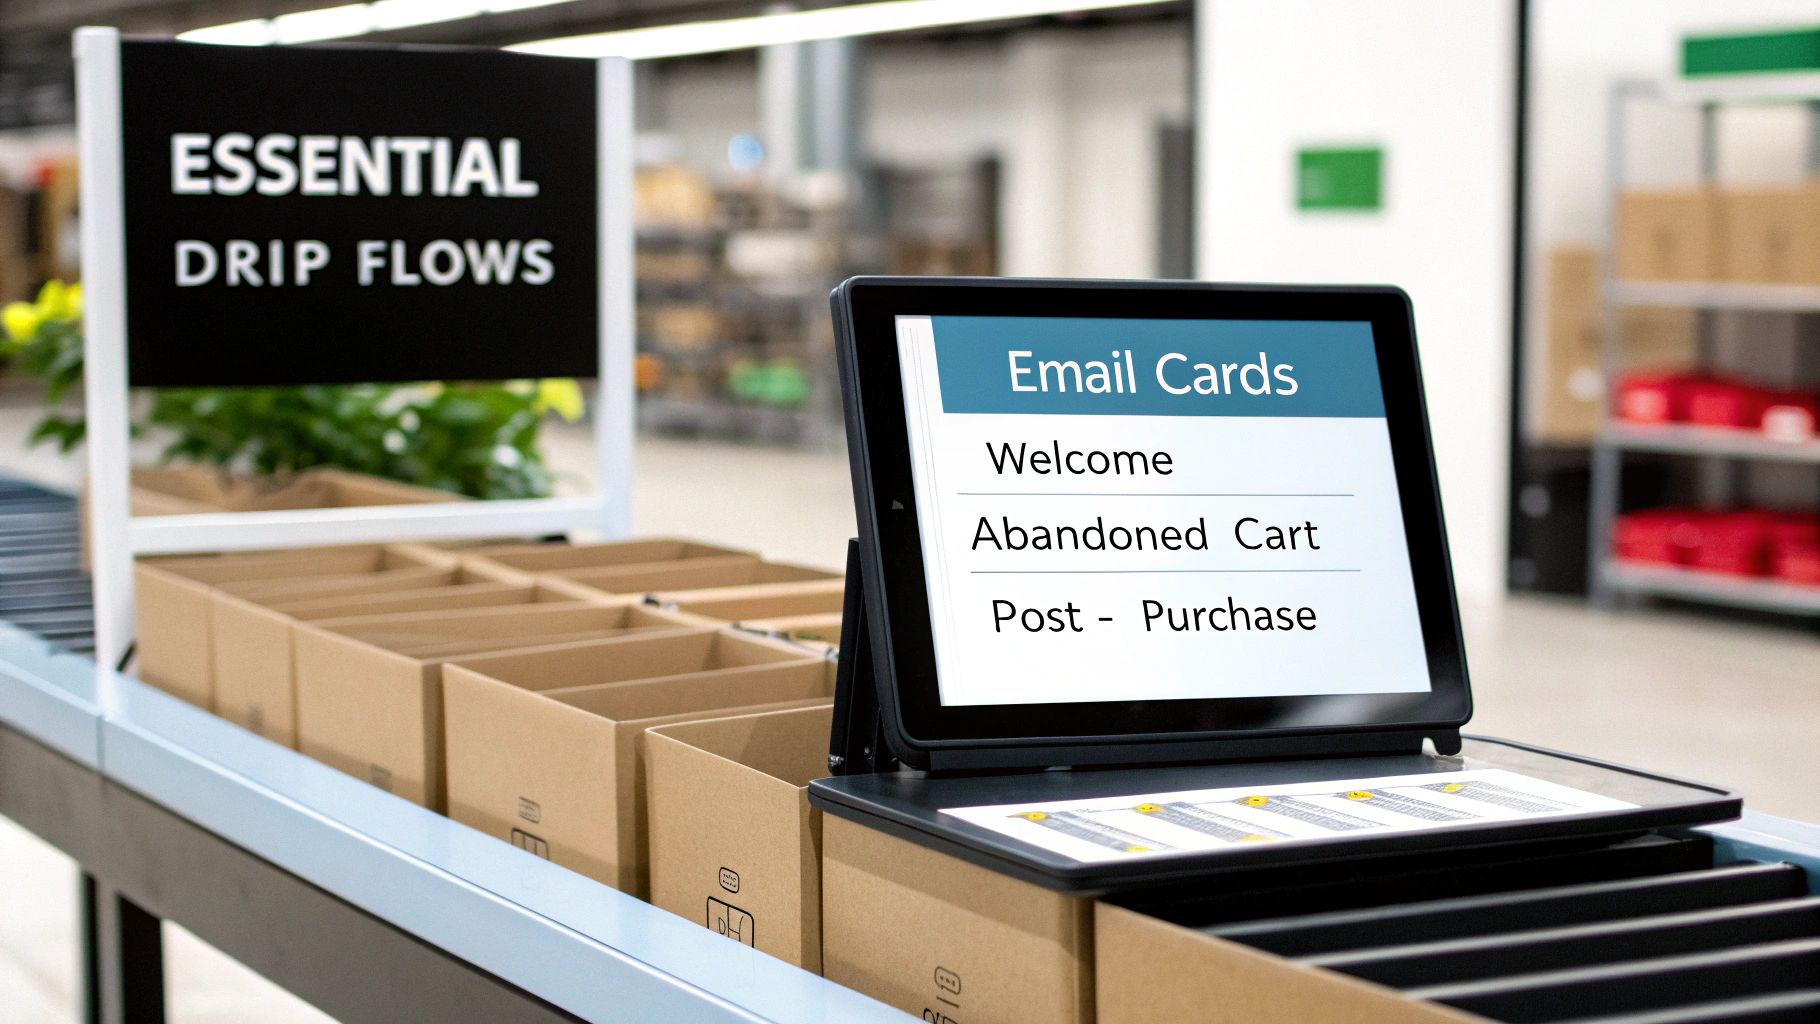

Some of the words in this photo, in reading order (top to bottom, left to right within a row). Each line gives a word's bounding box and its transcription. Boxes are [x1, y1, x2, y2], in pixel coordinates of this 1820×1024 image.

[171, 132, 539, 197] ESSENTIAL
[175, 239, 329, 287] DRIP
[357, 238, 554, 286] FLOWS
[1008, 349, 1137, 394] Email
[1155, 351, 1299, 396] Cards
[985, 439, 1174, 476] Welcome
[971, 516, 1209, 551] Abandoned
[1234, 517, 1322, 550] Cart
[992, 599, 1084, 633] Post
[1142, 596, 1317, 632] Purchase
